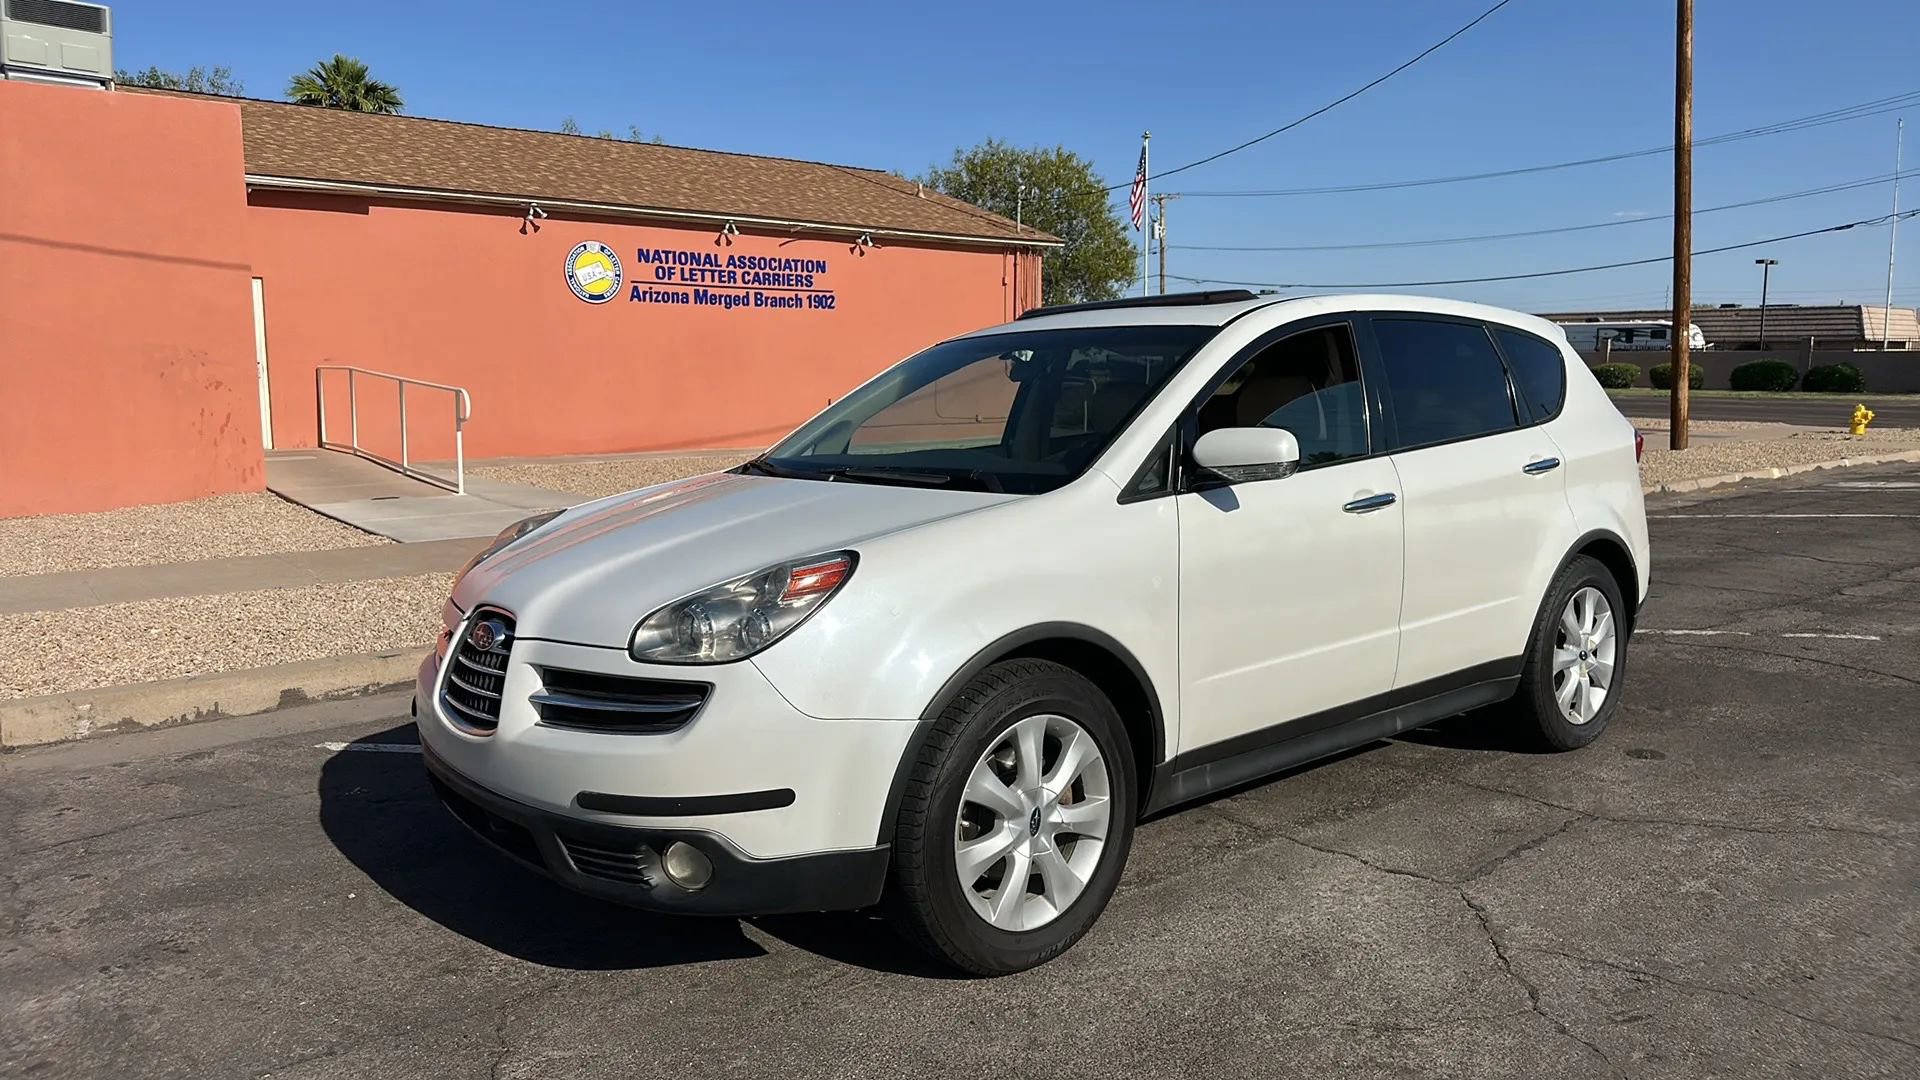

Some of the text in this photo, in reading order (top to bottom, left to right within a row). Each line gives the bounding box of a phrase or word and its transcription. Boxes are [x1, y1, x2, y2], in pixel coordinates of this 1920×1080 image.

[637, 248, 827, 274] NATIONAL ASSOCIATION
[654, 265, 814, 288] OF LETTER CARRIERS
[629, 285, 835, 310] Arizona Merged Branch 1902
